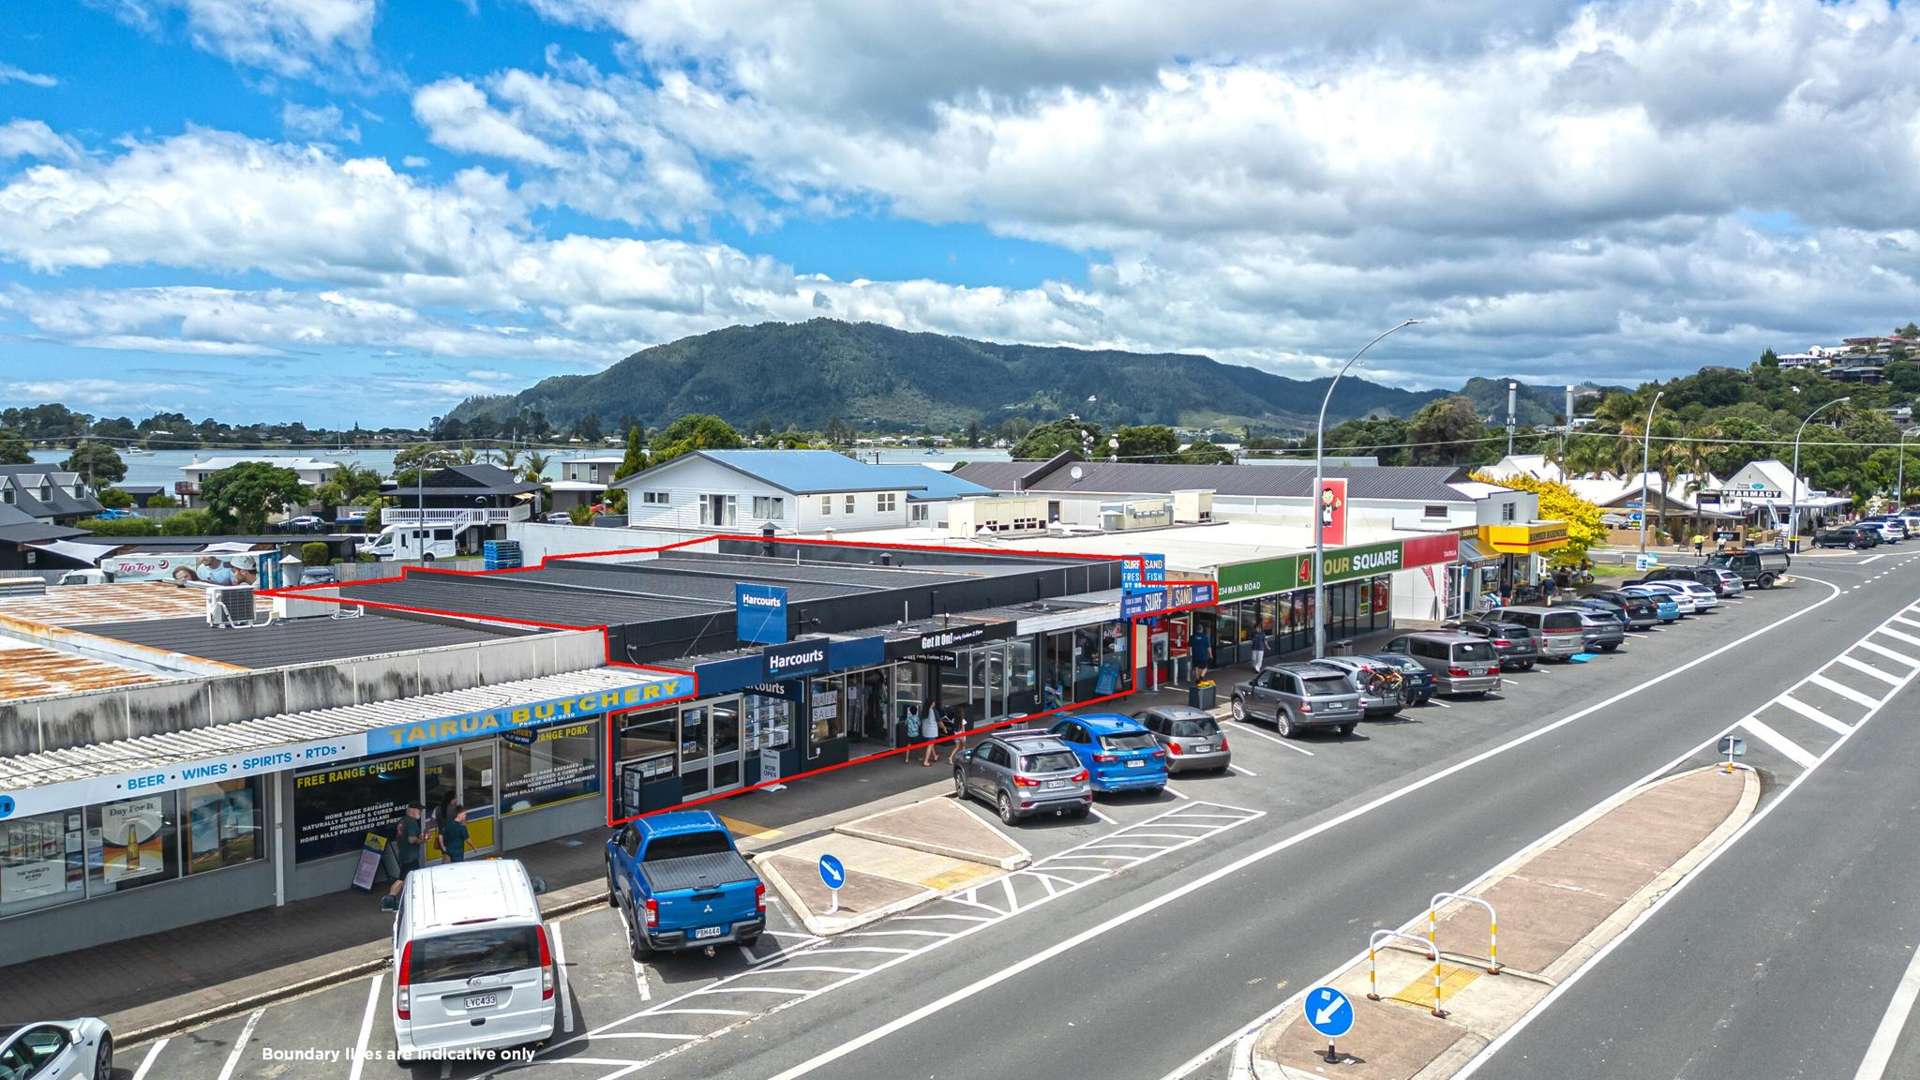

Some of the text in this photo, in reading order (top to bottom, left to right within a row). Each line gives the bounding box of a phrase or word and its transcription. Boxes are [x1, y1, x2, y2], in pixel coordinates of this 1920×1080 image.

[1124, 560, 1162, 570] SURF SAND
[1299, 550, 1398, 582] 4 OUR SQUARE
[1123, 573, 1162, 581] FRES FISH
[1228, 585, 1242, 594] MAIN
[1244, 582, 1260, 591] ROAD
[742, 594, 780, 607] Harcourts
[1145, 593, 1162, 612] SURF
[1176, 588, 1192, 606] SAND
[922, 636, 934, 649] Get
[770, 650, 824, 669] Harcourts
[388, 680, 678, 744] TAIRUA BUTCHERY
[566, 725, 588, 738] PORK
[128, 745, 337, 790] BEER WINES SPIRITS RTDs
[296, 758, 415, 788] FREE RANGE CHICKEN
[110, 808, 128, 816] Day
[302, 819, 338, 832] NATURALLY
[466, 995, 496, 1008] LYC433
